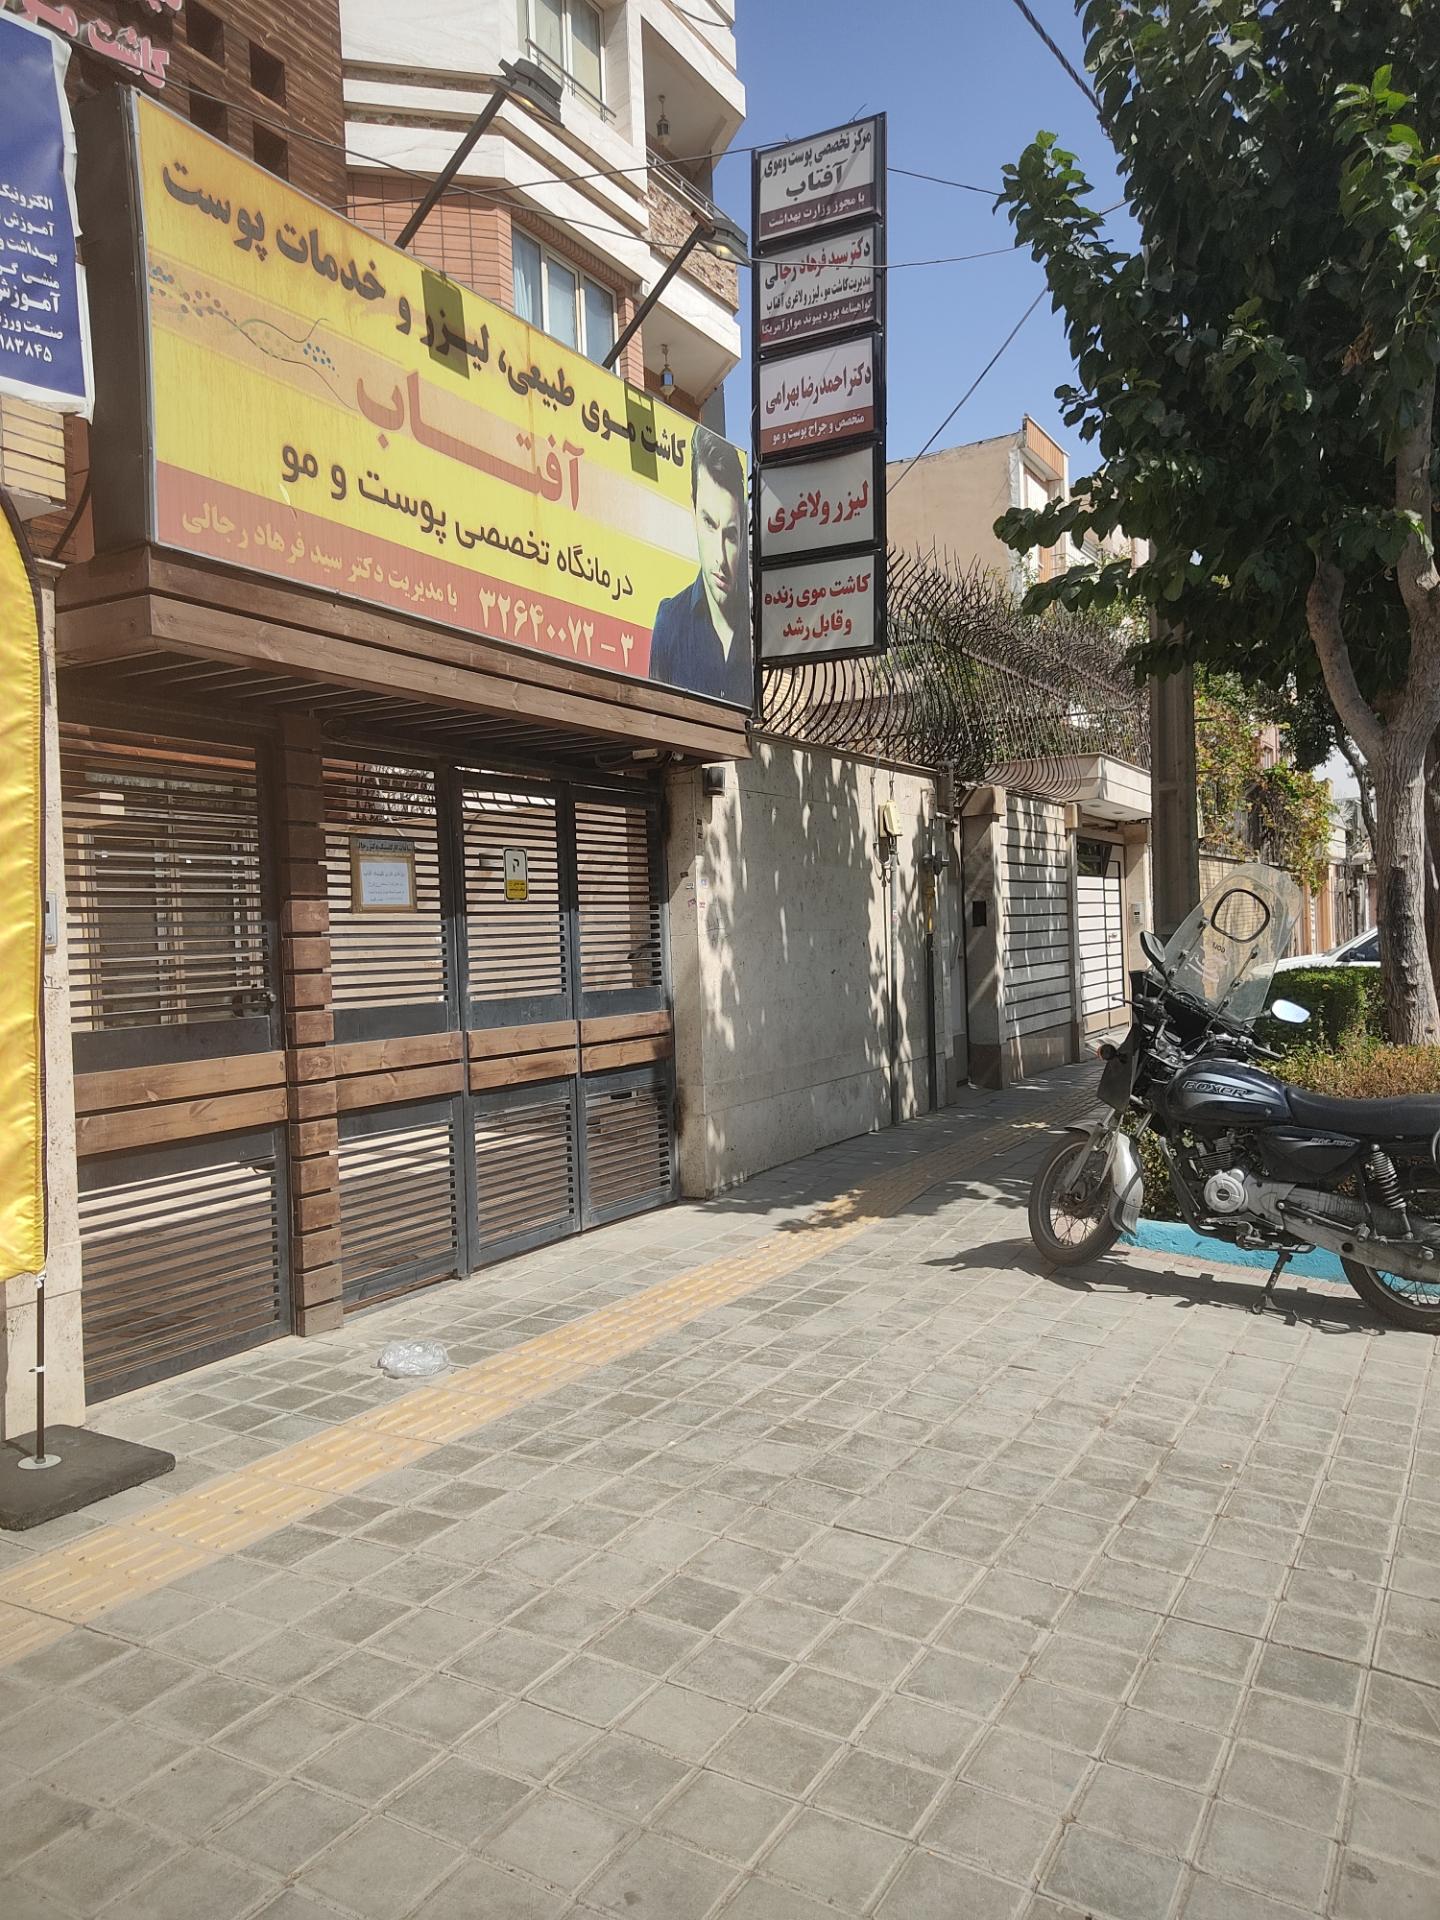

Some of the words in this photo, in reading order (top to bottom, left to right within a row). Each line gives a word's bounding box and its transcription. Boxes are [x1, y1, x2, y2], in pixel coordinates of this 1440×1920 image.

[88, 18, 169, 88] کاشت
[814, 134, 850, 163] تخصصی
[851, 128, 872, 154] مرکز
[787, 149, 812, 168] پوست
[786, 158, 848, 201] آفتاب
[163, 162, 268, 262] پوست
[803, 203, 831, 219] وزارت
[832, 197, 856, 213] مجوز
[858, 191, 865, 206] با
[3, 211, 55, 237] آموزش
[768, 211, 802, 228] بهداشت
[6, 238, 58, 267] بهداشت
[276, 224, 386, 301] خدمات
[800, 248, 828, 277] فرهاد
[828, 251, 848, 270] سید
[849, 236, 871, 269] دکتر
[21, 272, 60, 289] منشی
[764, 262, 797, 289] رجالی
[849, 276, 871, 292] مدیریت
[396, 297, 411, 336] و
[766, 293, 785, 314] آفتاب
[23, 321, 64, 340] صنعت
[420, 309, 489, 371] لیزر
[847, 362, 872, 397] دکتر
[765, 381, 800, 414] بهرامی
[582, 401, 636, 441] موی
[787, 428, 808, 440] پوست
[808, 421, 828, 439] جراح
[836, 411, 865, 431] متخصص
[357, 371, 585, 512] آفتاب
[641, 427, 686, 467] کاشت
[771, 433, 781, 446] مو
[281, 445, 319, 484] مو
[330, 465, 348, 502] و
[358, 471, 447, 544] پوست
[767, 489, 822, 533] لاغری
[832, 480, 869, 524] لیزر
[181, 503, 250, 550] رجالی
[253, 523, 305, 564] فرهاد
[455, 522, 551, 566] تخصصی
[310, 545, 343, 572] سید
[347, 557, 384, 582] دکتر
[386, 569, 445, 602] مدیریت
[557, 545, 634, 601] درمانگاه
[829, 573, 872, 597] کاشت
[446, 583, 458, 611] با
[763, 585, 794, 609] زنده
[796, 587, 827, 608] موی
[783, 617, 811, 640] رشد
[1182, 1080, 1248, 1098] BOXER
